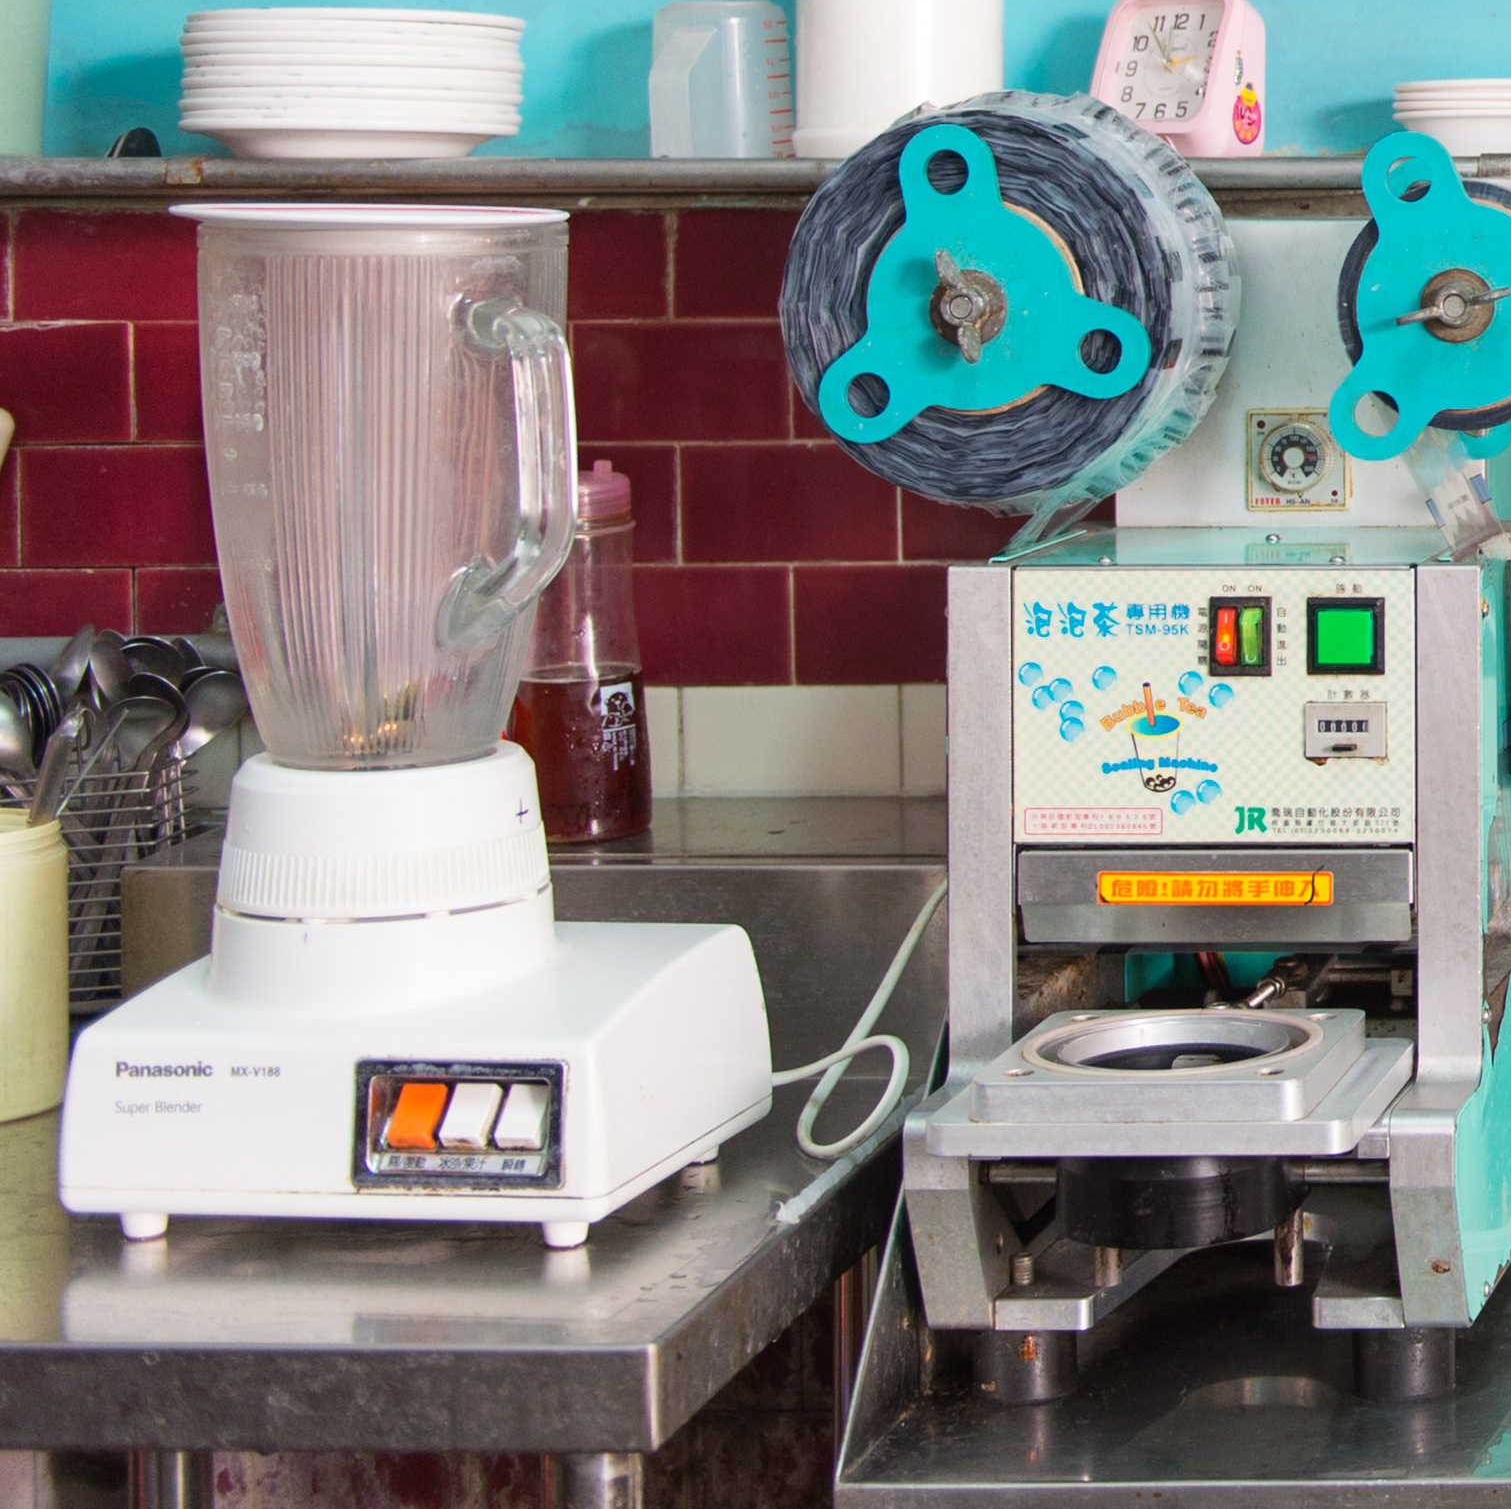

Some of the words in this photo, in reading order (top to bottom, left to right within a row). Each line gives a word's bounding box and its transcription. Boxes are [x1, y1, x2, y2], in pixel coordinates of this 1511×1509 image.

[1153, 15, 1166, 32] 11
[1173, 13, 1190, 30] 12
[1199, 14, 1206, 31] 1
[1132, 35, 1149, 52] 10
[1125, 61, 1138, 77] 9
[1121, 86, 1133, 102] 8
[1135, 103, 1146, 119] 7
[1154, 103, 1166, 119] 6
[1175, 101, 1189, 118] 5
[1023, 602, 1120, 638] 泡泡茶
[1126, 624, 1189, 635] TSM-95K
[1177, 697, 1207, 719] Tea
[1159, 757, 1218, 773] Machine
[1235, 806, 1268, 835] JR
[1111, 879, 1320, 899] 危險!請勿將手伸入
[116, 1061, 213, 1077] Panasonic
[231, 1066, 280, 1077] MX-V188
[115, 1101, 151, 1116] Super
[155, 1100, 202, 1113] Blender
